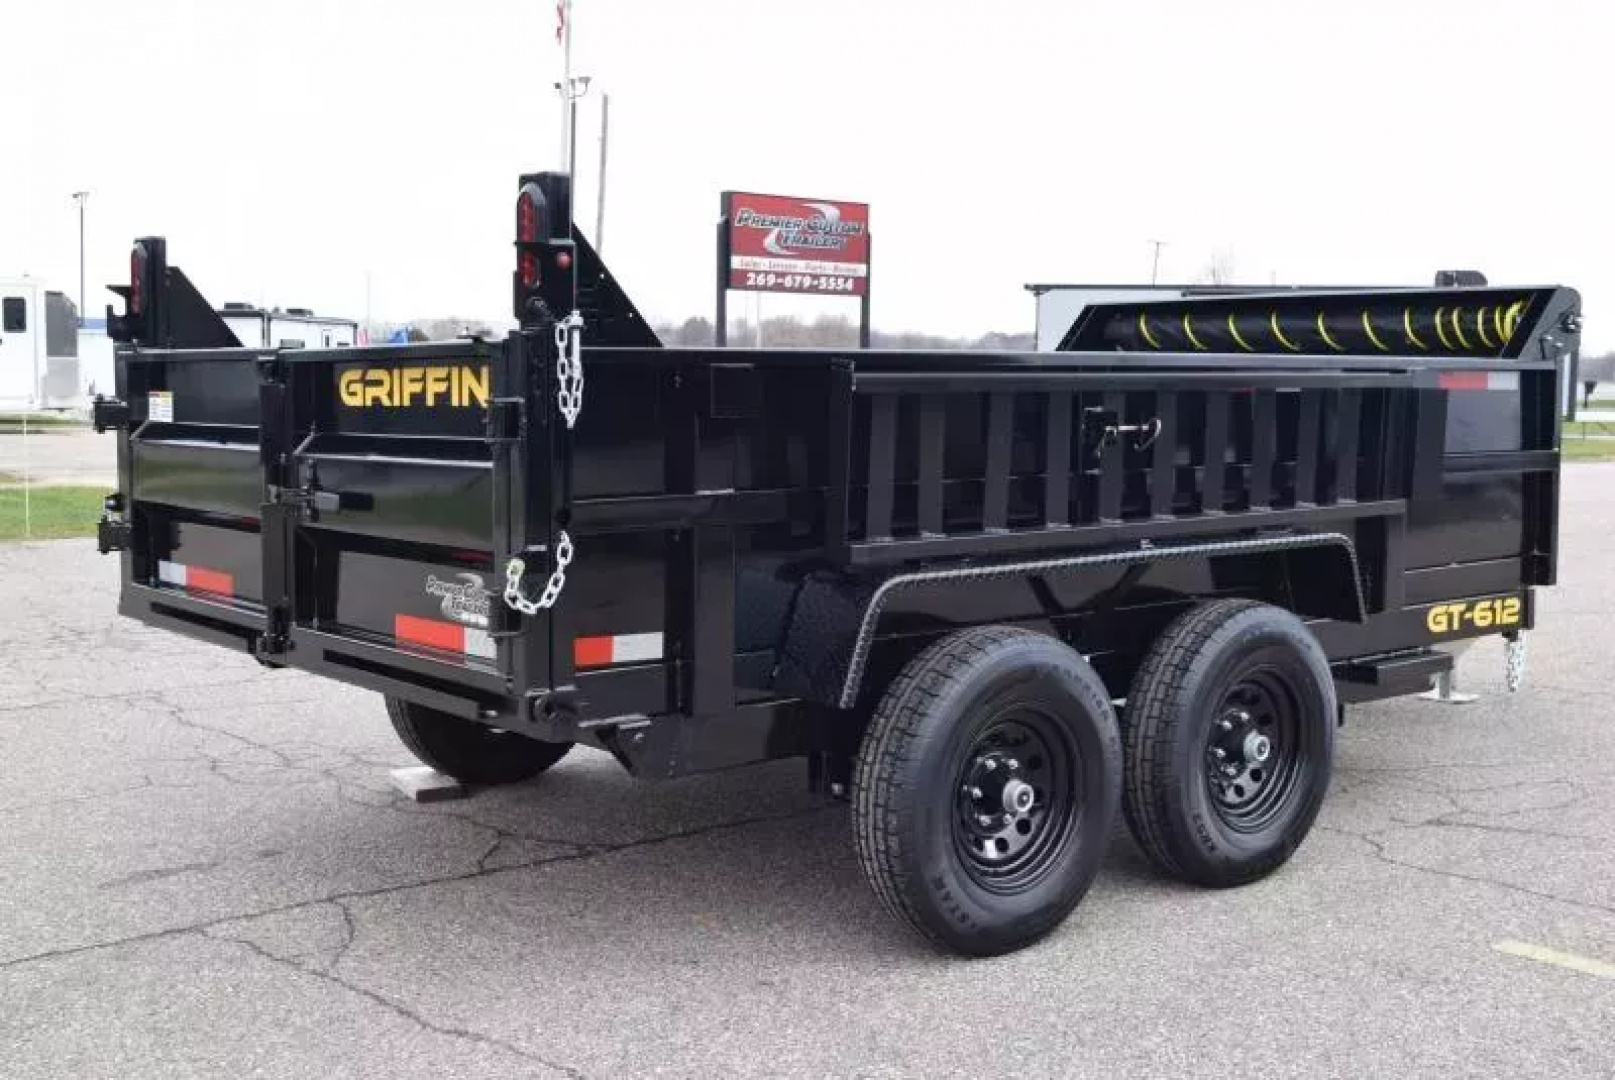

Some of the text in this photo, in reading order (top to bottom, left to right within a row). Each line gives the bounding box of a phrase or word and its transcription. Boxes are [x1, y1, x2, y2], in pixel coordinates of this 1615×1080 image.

[735, 208, 803, 229] PREMIER
[746, 272, 854, 292] 269-679-5554
[339, 364, 490, 408] GRIFFIN
[1426, 596, 1521, 633] GT-612
